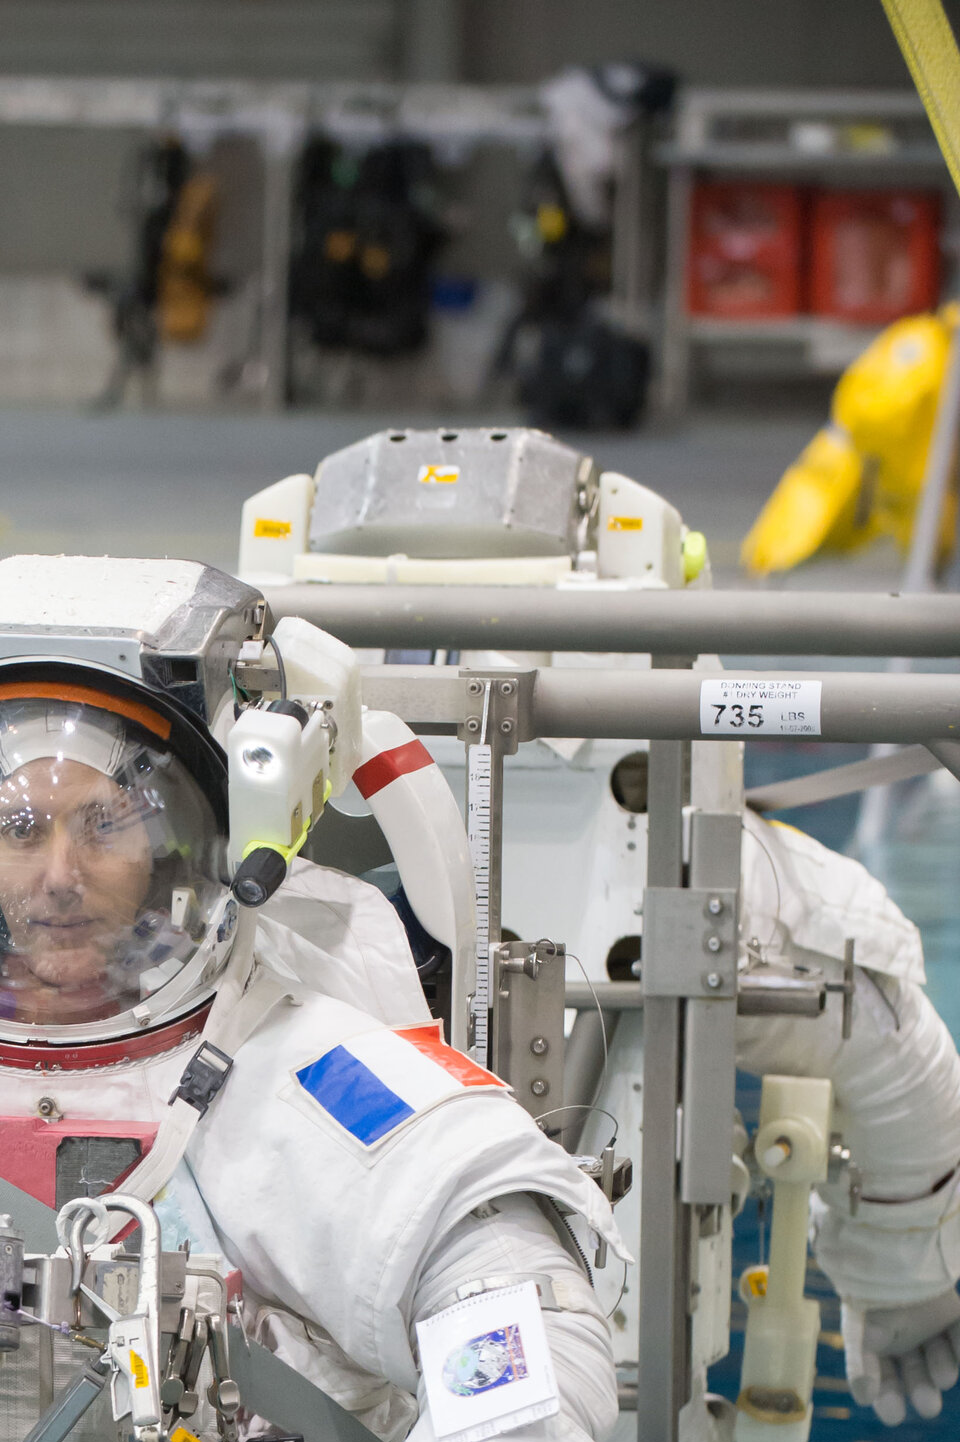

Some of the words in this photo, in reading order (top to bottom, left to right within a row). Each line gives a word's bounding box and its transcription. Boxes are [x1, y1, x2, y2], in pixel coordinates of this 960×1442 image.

[769, 682, 802, 690] STAND
[759, 691, 799, 699] WEIGHT
[711, 704, 765, 728] 735
[780, 711, 806, 721] LBS
